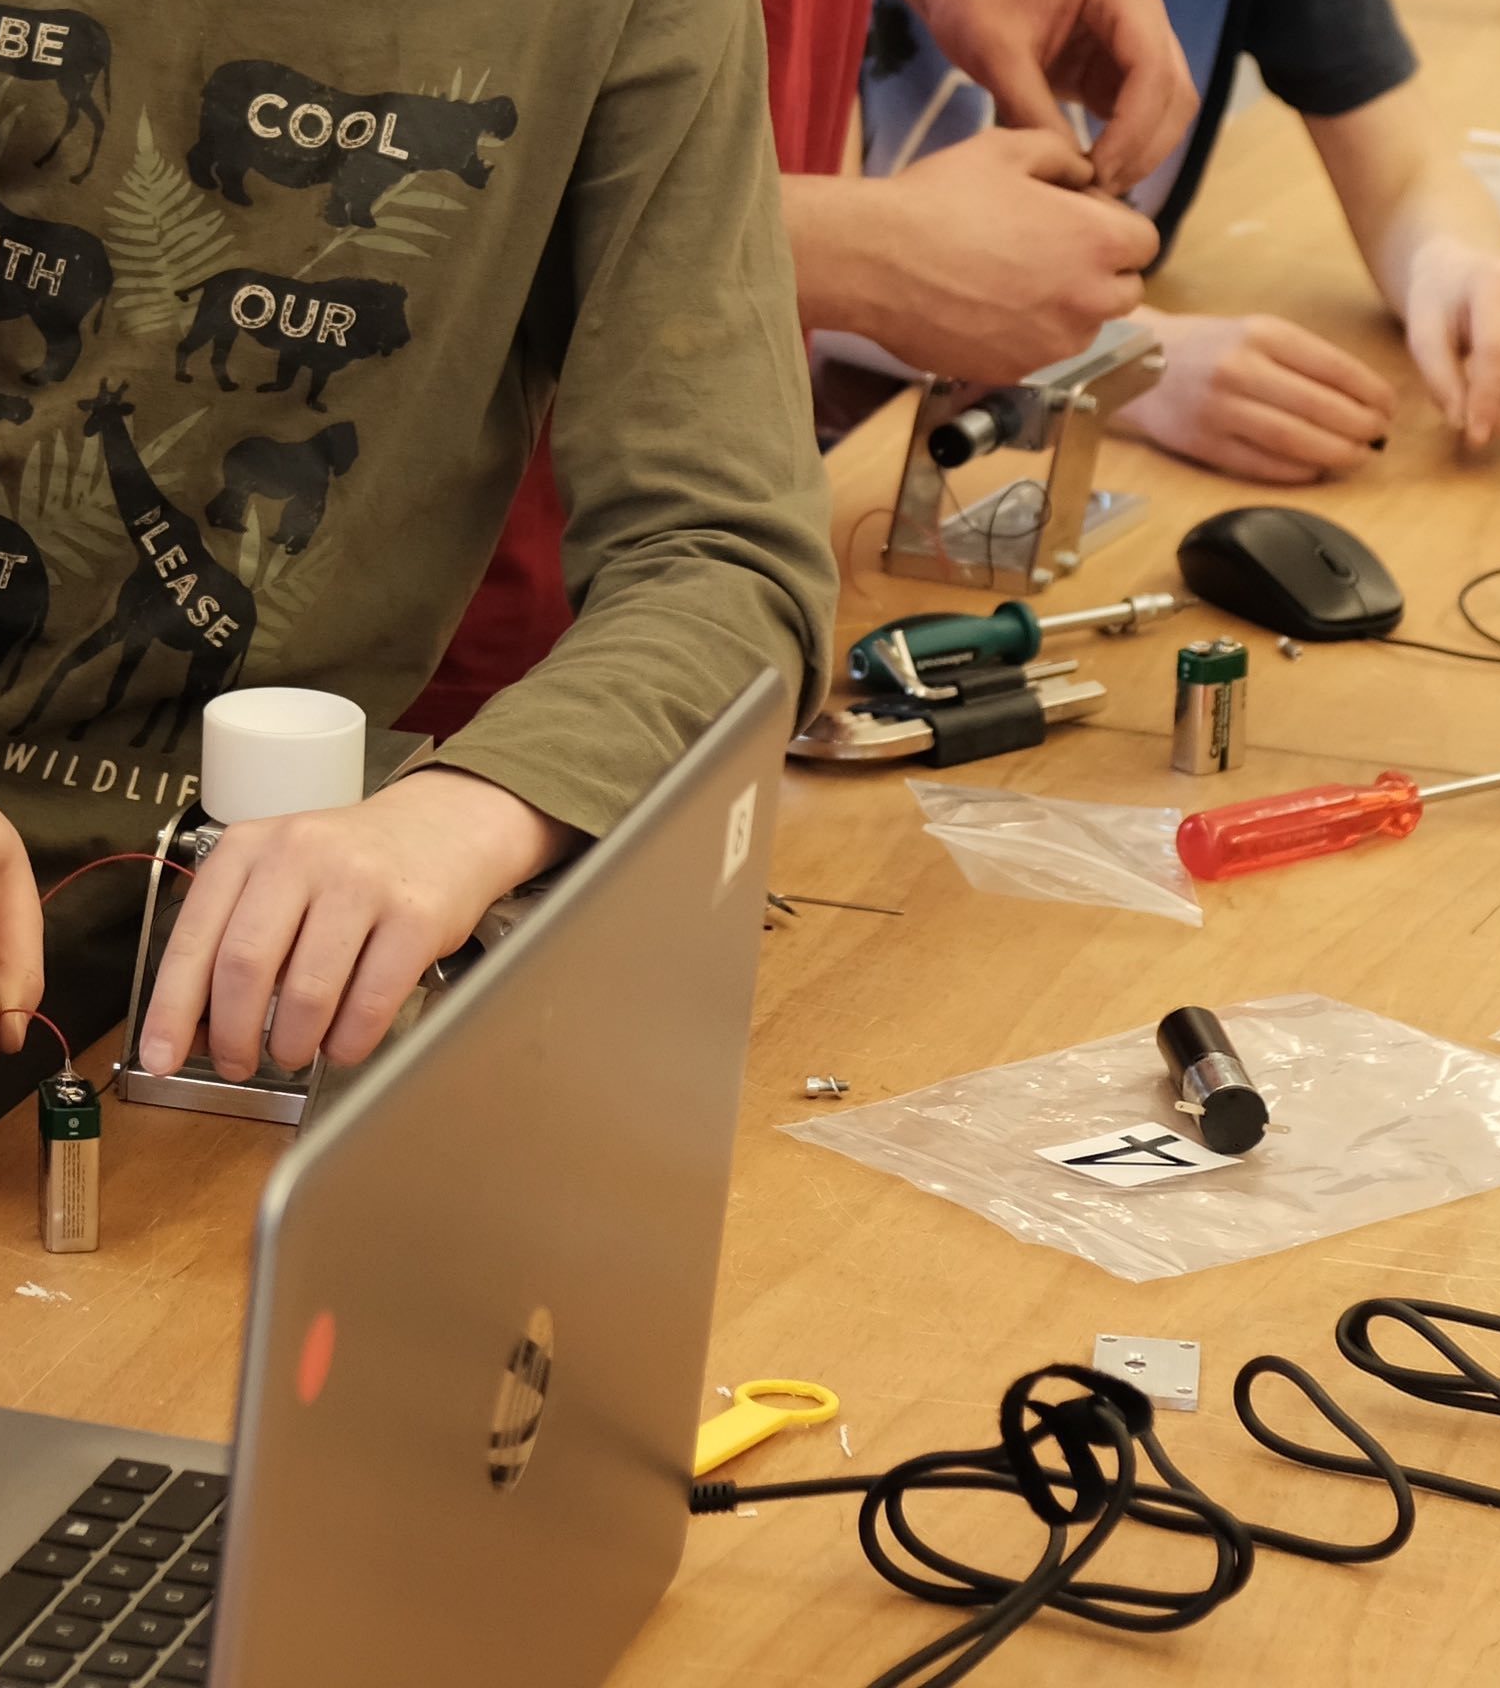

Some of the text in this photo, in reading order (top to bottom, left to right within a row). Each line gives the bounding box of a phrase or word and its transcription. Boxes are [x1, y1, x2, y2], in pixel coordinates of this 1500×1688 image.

[246, 93, 410, 162] COOL
[230, 283, 357, 348] OUR
[134, 507, 240, 650] PLEASE
[3, 742, 199, 807] WILDLIF
[1061, 1134, 1200, 1168] 4
